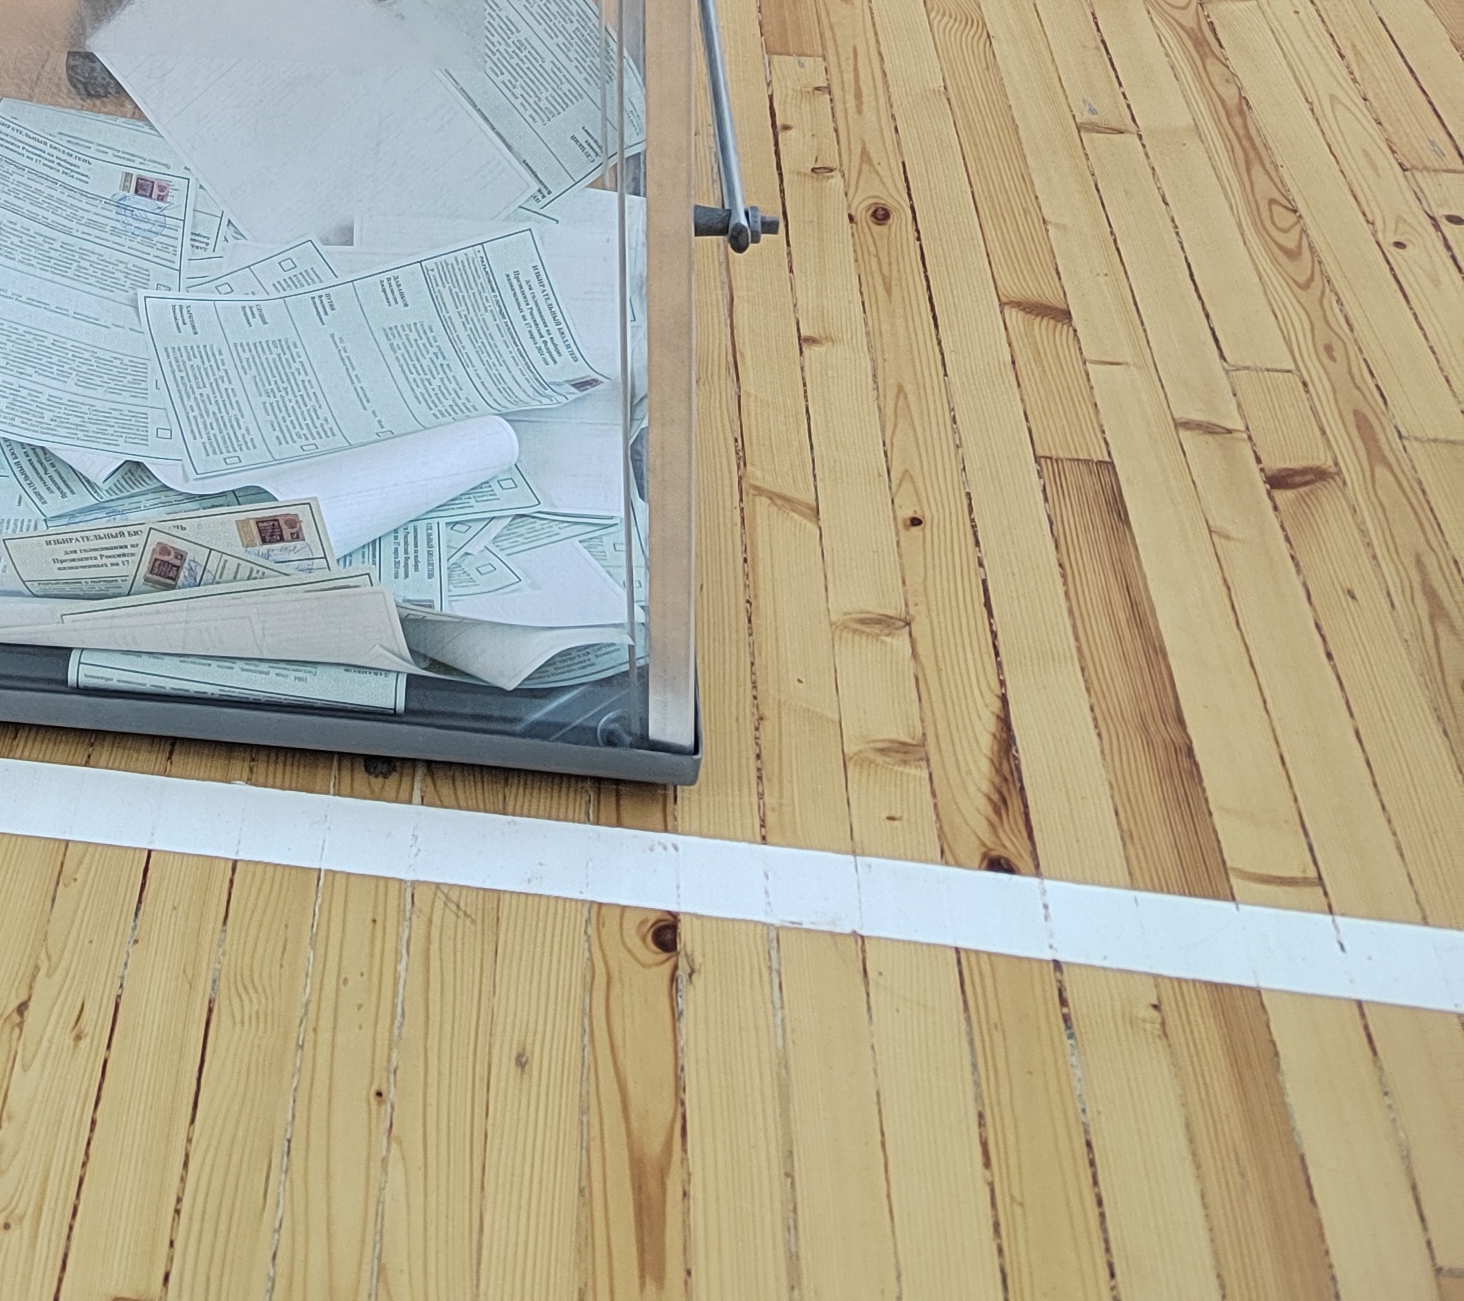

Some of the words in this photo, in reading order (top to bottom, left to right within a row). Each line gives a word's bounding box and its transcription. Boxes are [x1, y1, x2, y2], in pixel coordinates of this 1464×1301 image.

[44, 530, 127, 546] ИЗБИРАТЕЛЬНЫЙ
[52, 554, 98, 565] Президента
[121, 559, 130, 567] 17
